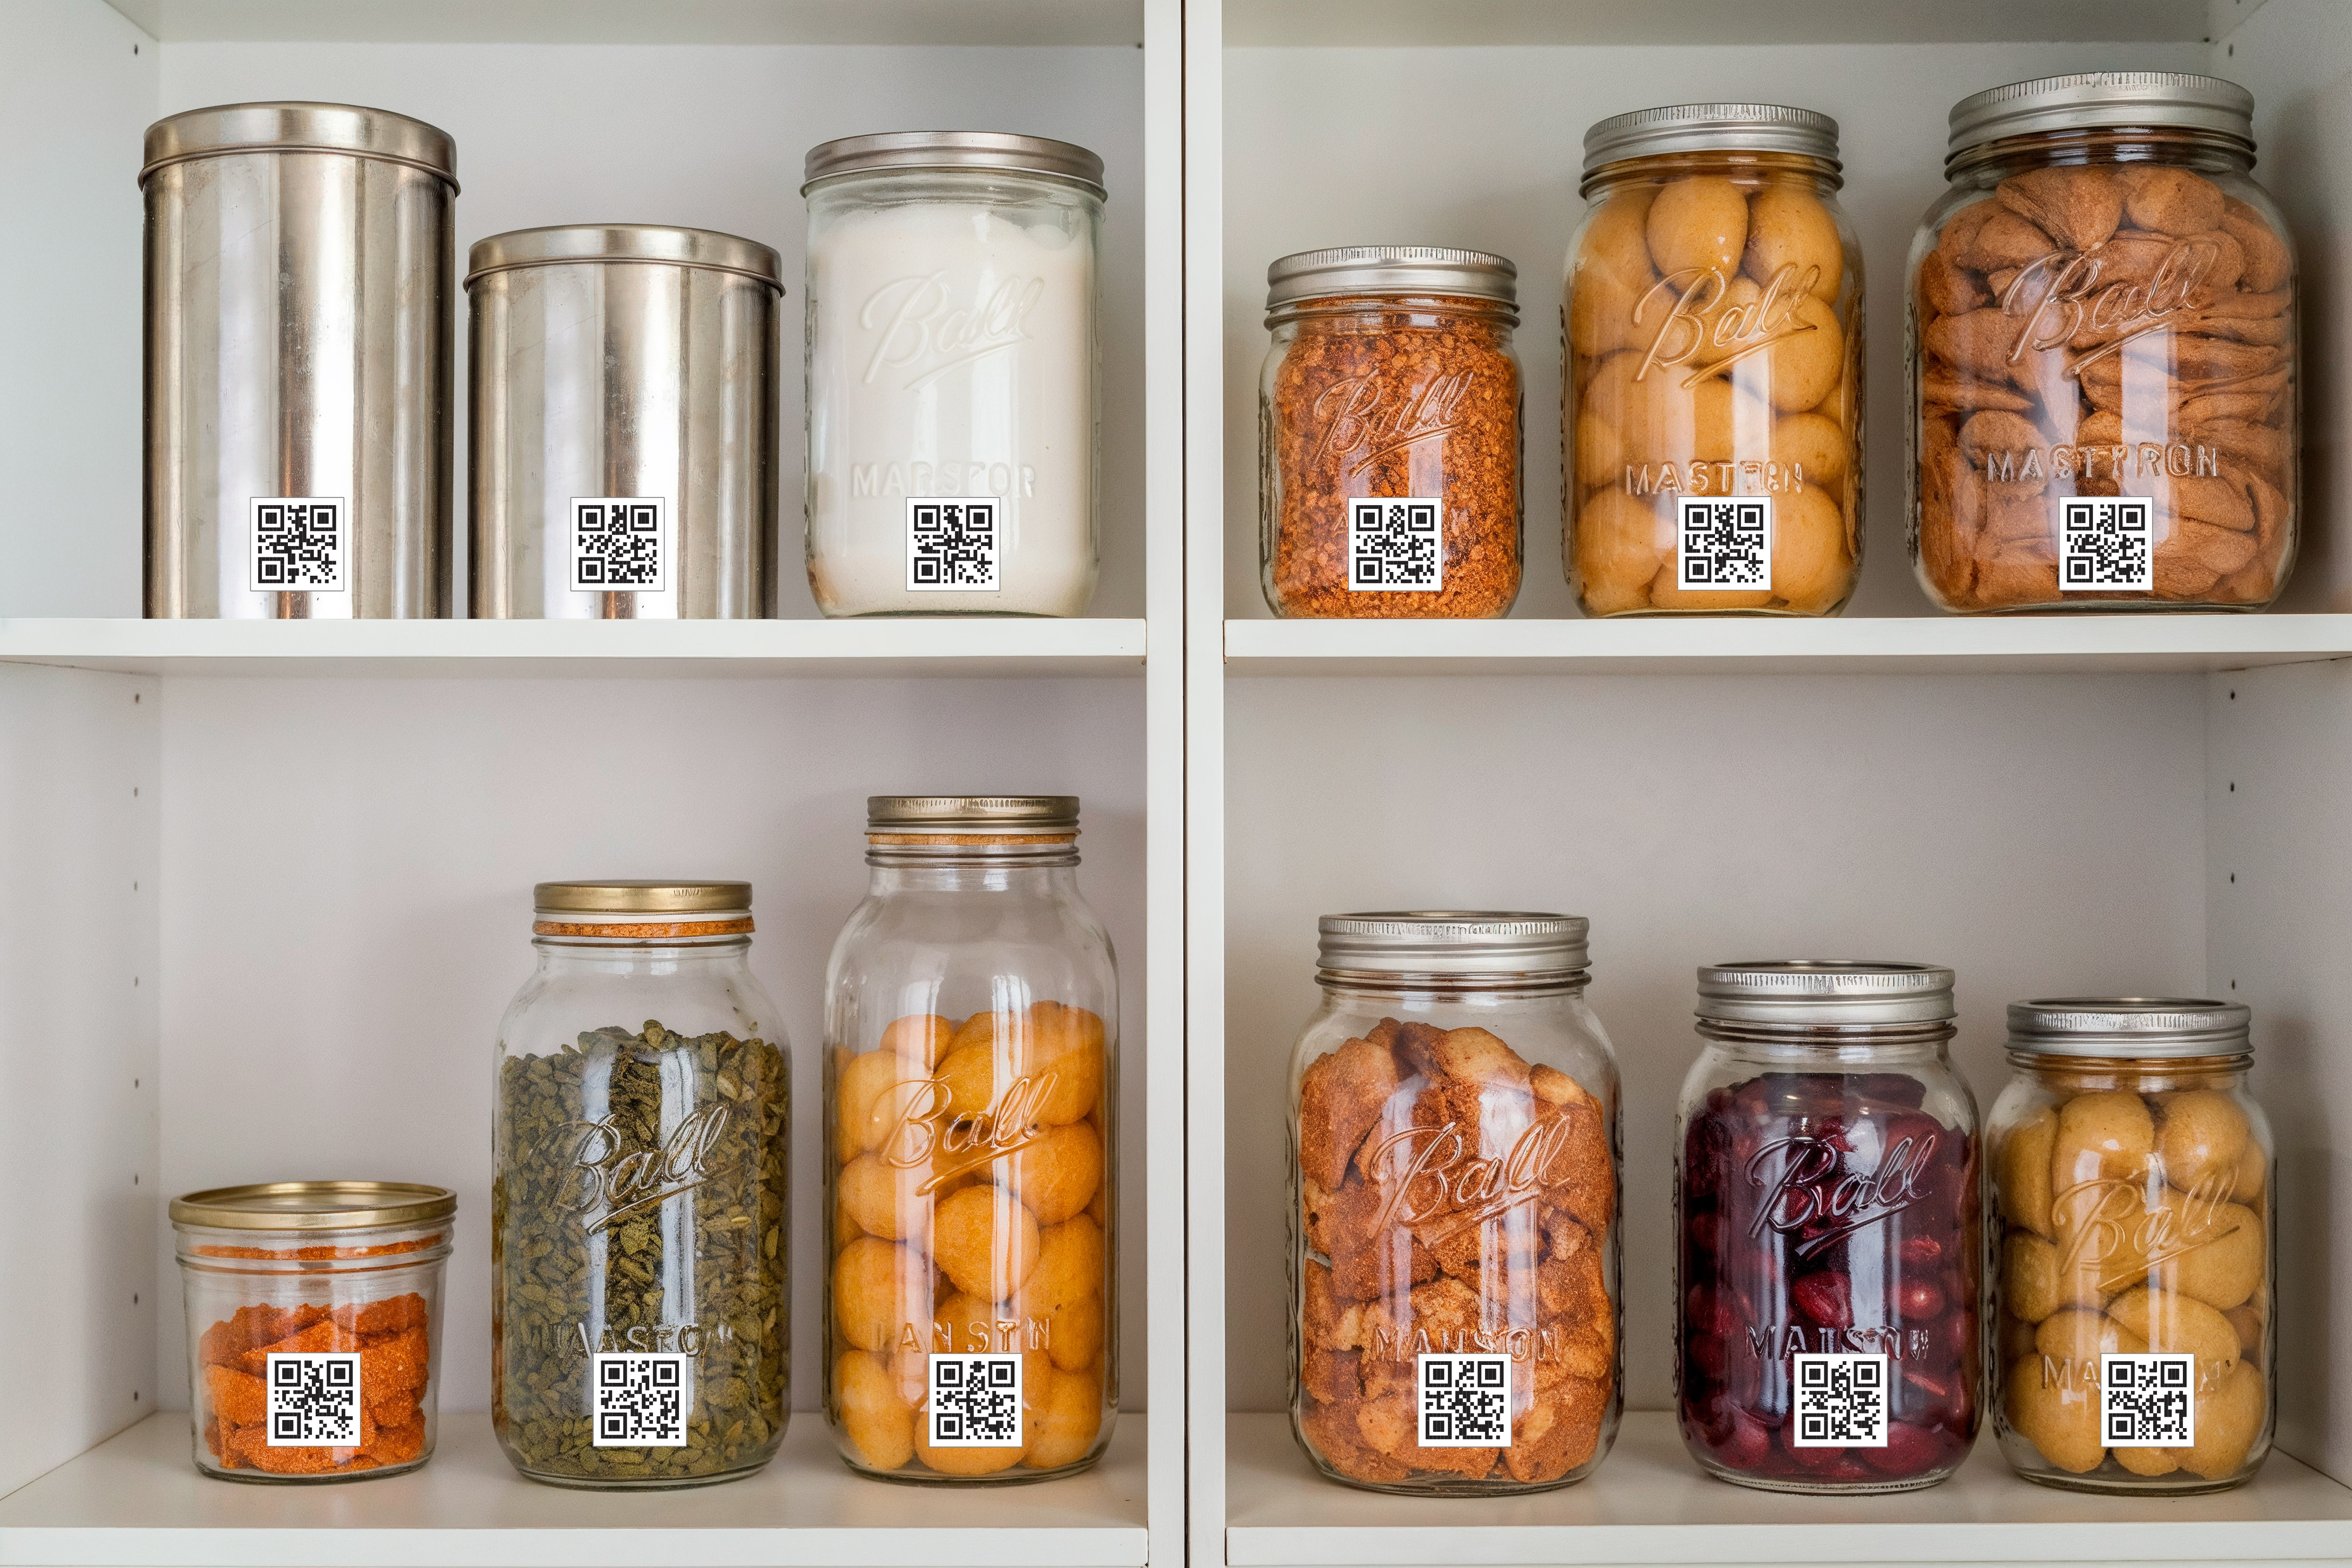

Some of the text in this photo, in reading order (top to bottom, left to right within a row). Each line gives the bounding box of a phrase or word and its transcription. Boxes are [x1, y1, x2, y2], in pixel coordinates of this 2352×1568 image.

[858, 270, 1045, 384] Ball
[1314, 368, 1474, 464] Ball
[530, 1104, 729, 1213] Ball
[870, 1072, 1057, 1168] Ball
[1368, 1115, 1570, 1239] Ball
[1744, 1135, 1935, 1239] Ball
[2052, 1166, 2239, 1275] Ball
